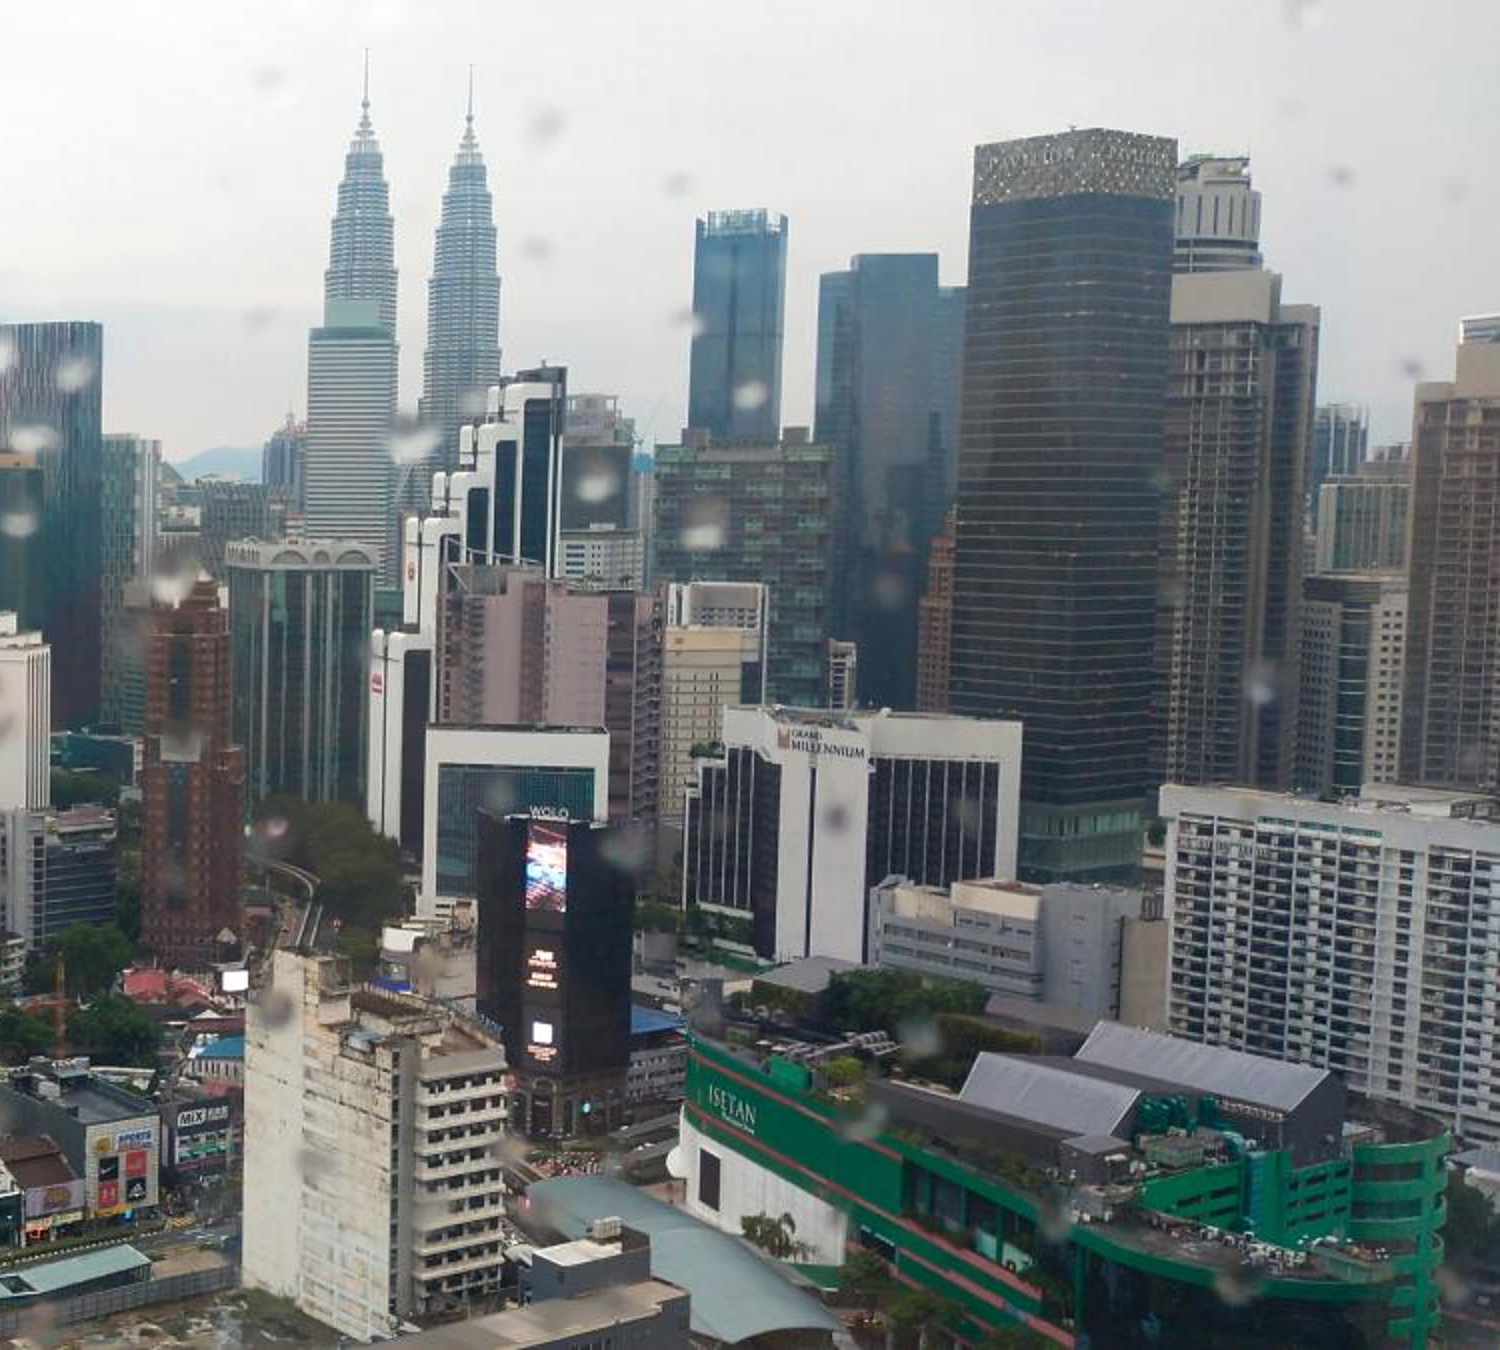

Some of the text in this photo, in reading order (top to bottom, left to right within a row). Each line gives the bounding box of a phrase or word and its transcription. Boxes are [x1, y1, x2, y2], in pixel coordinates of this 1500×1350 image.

[791, 740, 865, 758] MILLENNIUM
[529, 805, 569, 821] WOLO
[709, 1084, 756, 1124] ISETAN
